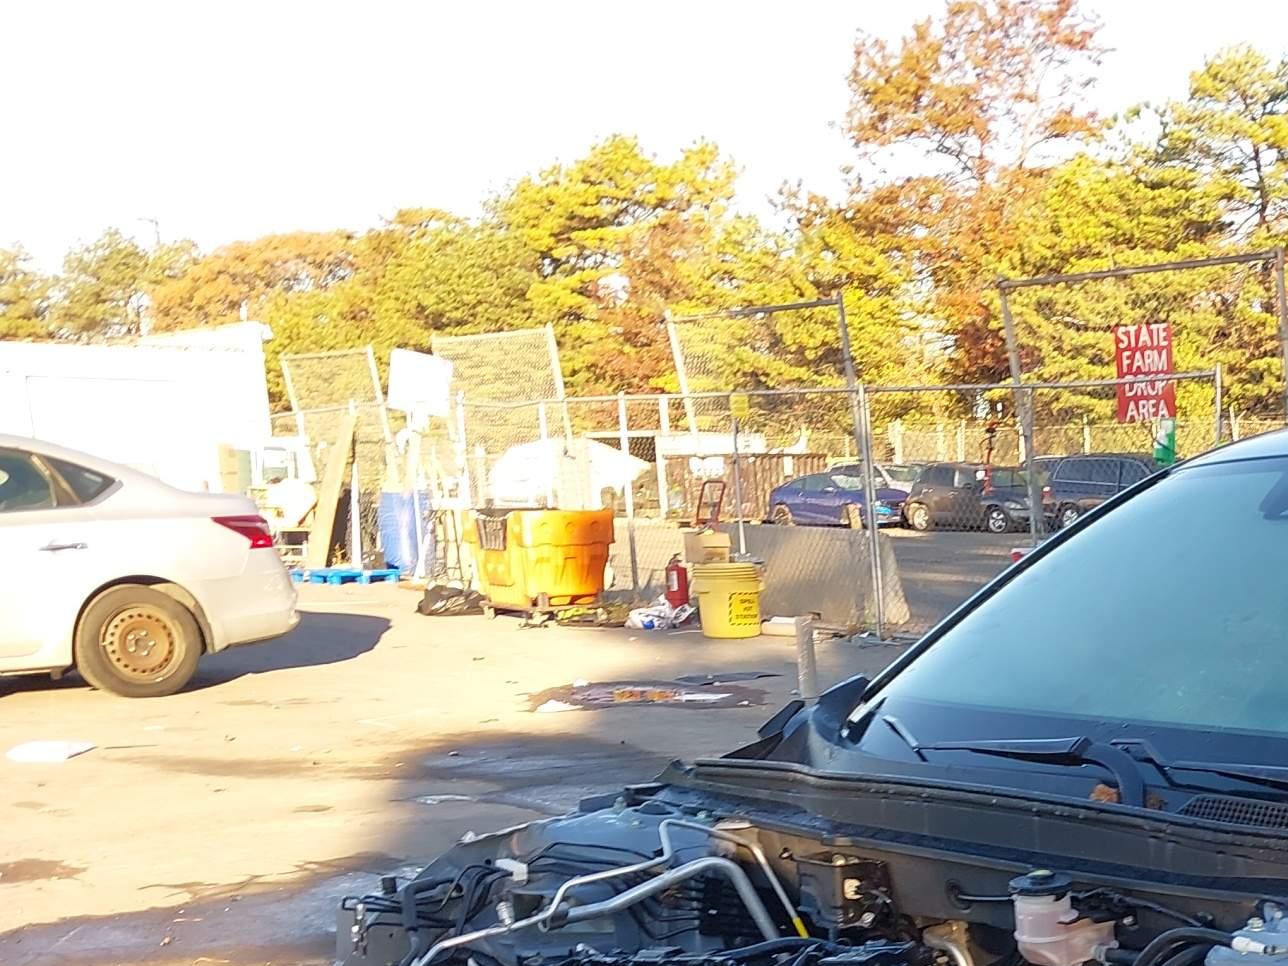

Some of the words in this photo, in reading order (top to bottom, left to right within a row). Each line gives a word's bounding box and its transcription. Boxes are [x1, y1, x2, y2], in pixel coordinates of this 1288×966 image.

[1117, 323, 1169, 349] STATE
[1121, 349, 1167, 373] FARM
[1124, 374, 1168, 397] DROP
[1125, 399, 1170, 422] AREA
